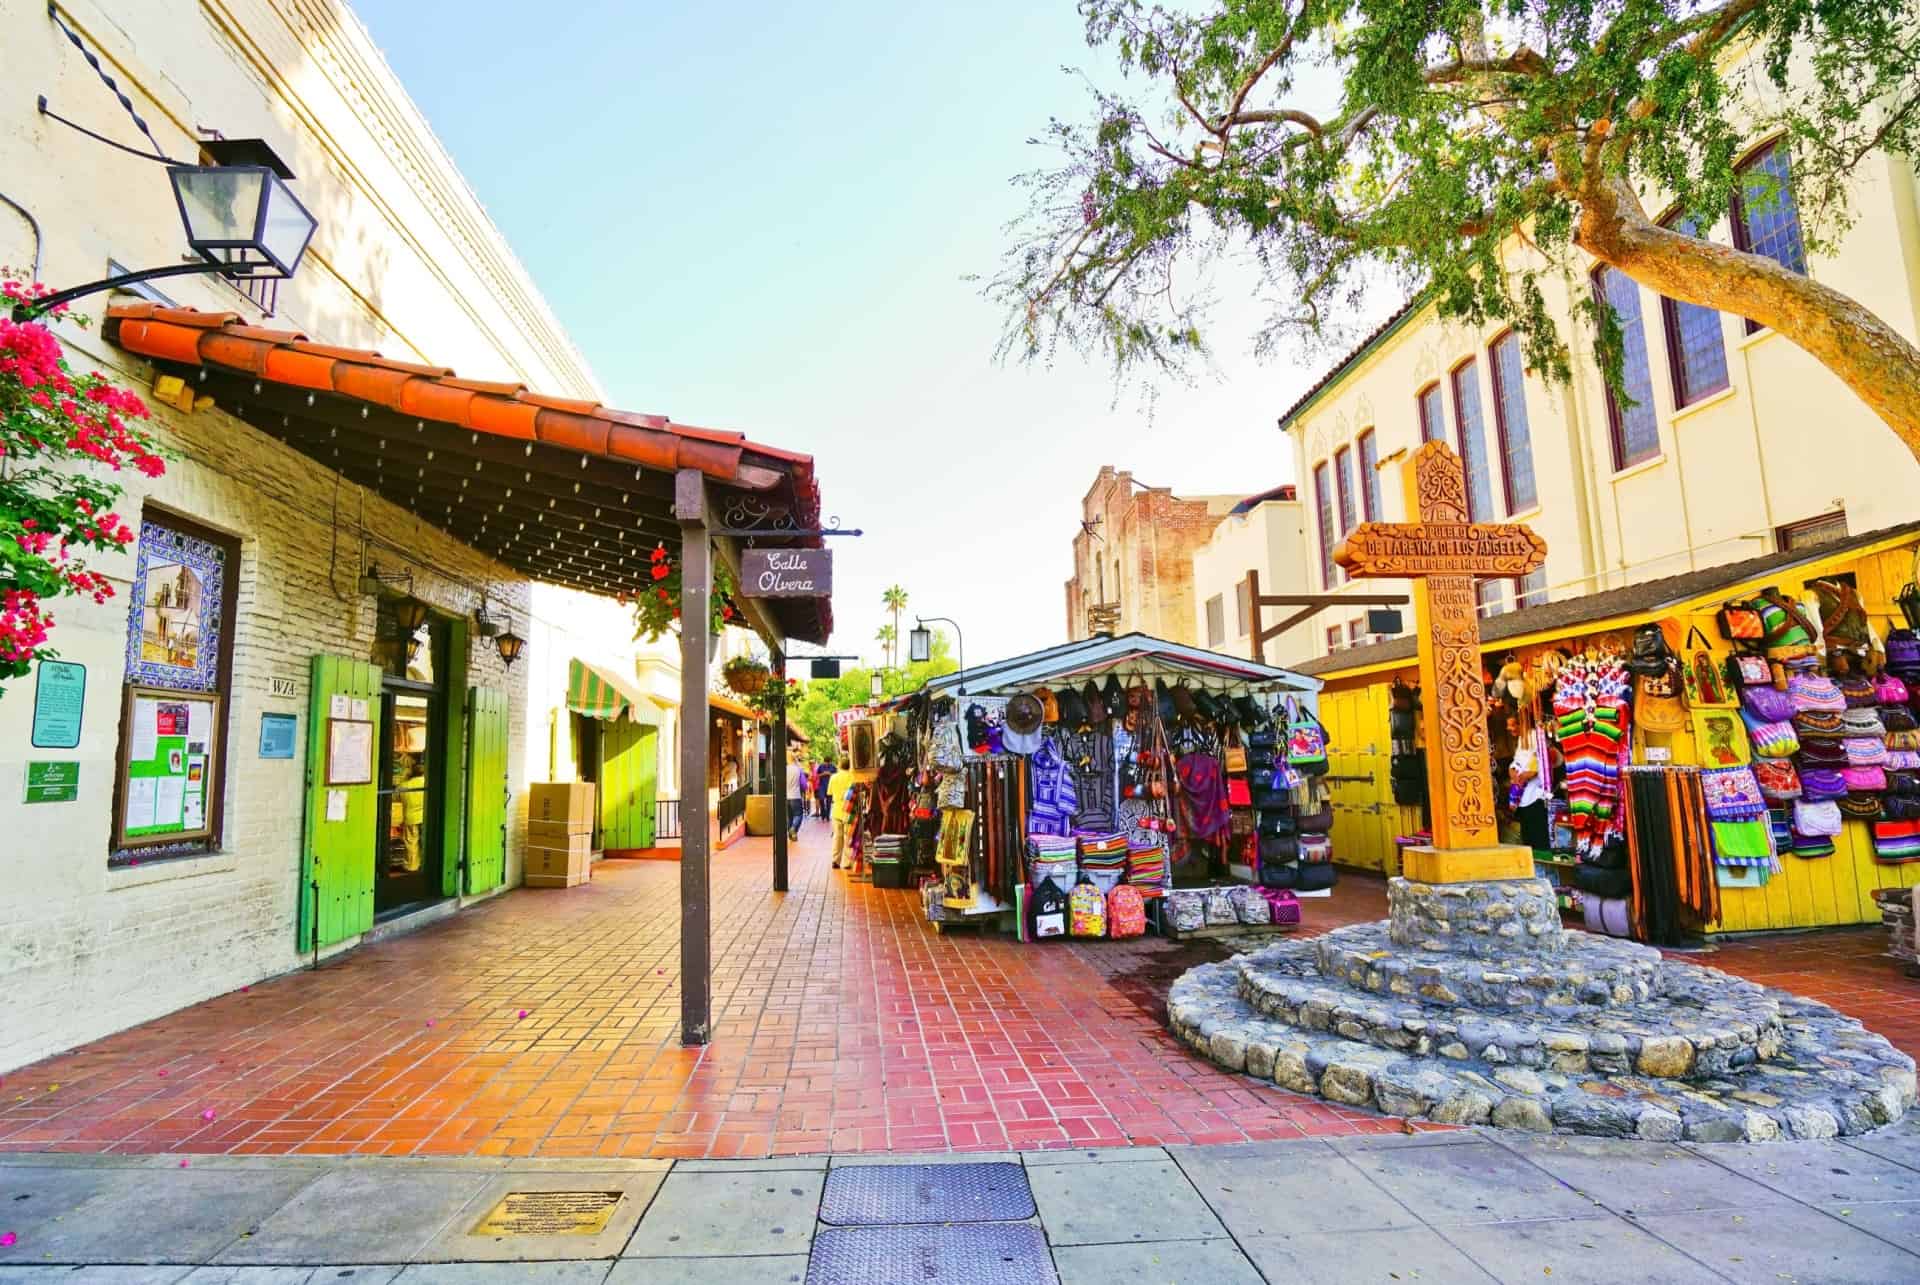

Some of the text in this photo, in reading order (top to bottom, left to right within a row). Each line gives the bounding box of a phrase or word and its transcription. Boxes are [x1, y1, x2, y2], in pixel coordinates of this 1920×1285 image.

[1437, 508, 1449, 521] EL
[1428, 526, 1466, 539] PUEBLO
[1367, 541, 1527, 556] DE LA REYNA DE LOS ANGELES
[767, 552, 808, 570] Calle
[1405, 558, 1441, 570] FELIPE
[1445, 558, 1460, 570] DE
[758, 571, 814, 592] Olvera
[1427, 576, 1473, 590] SEPTEMBER
[1433, 593, 1470, 606] FOURTH
